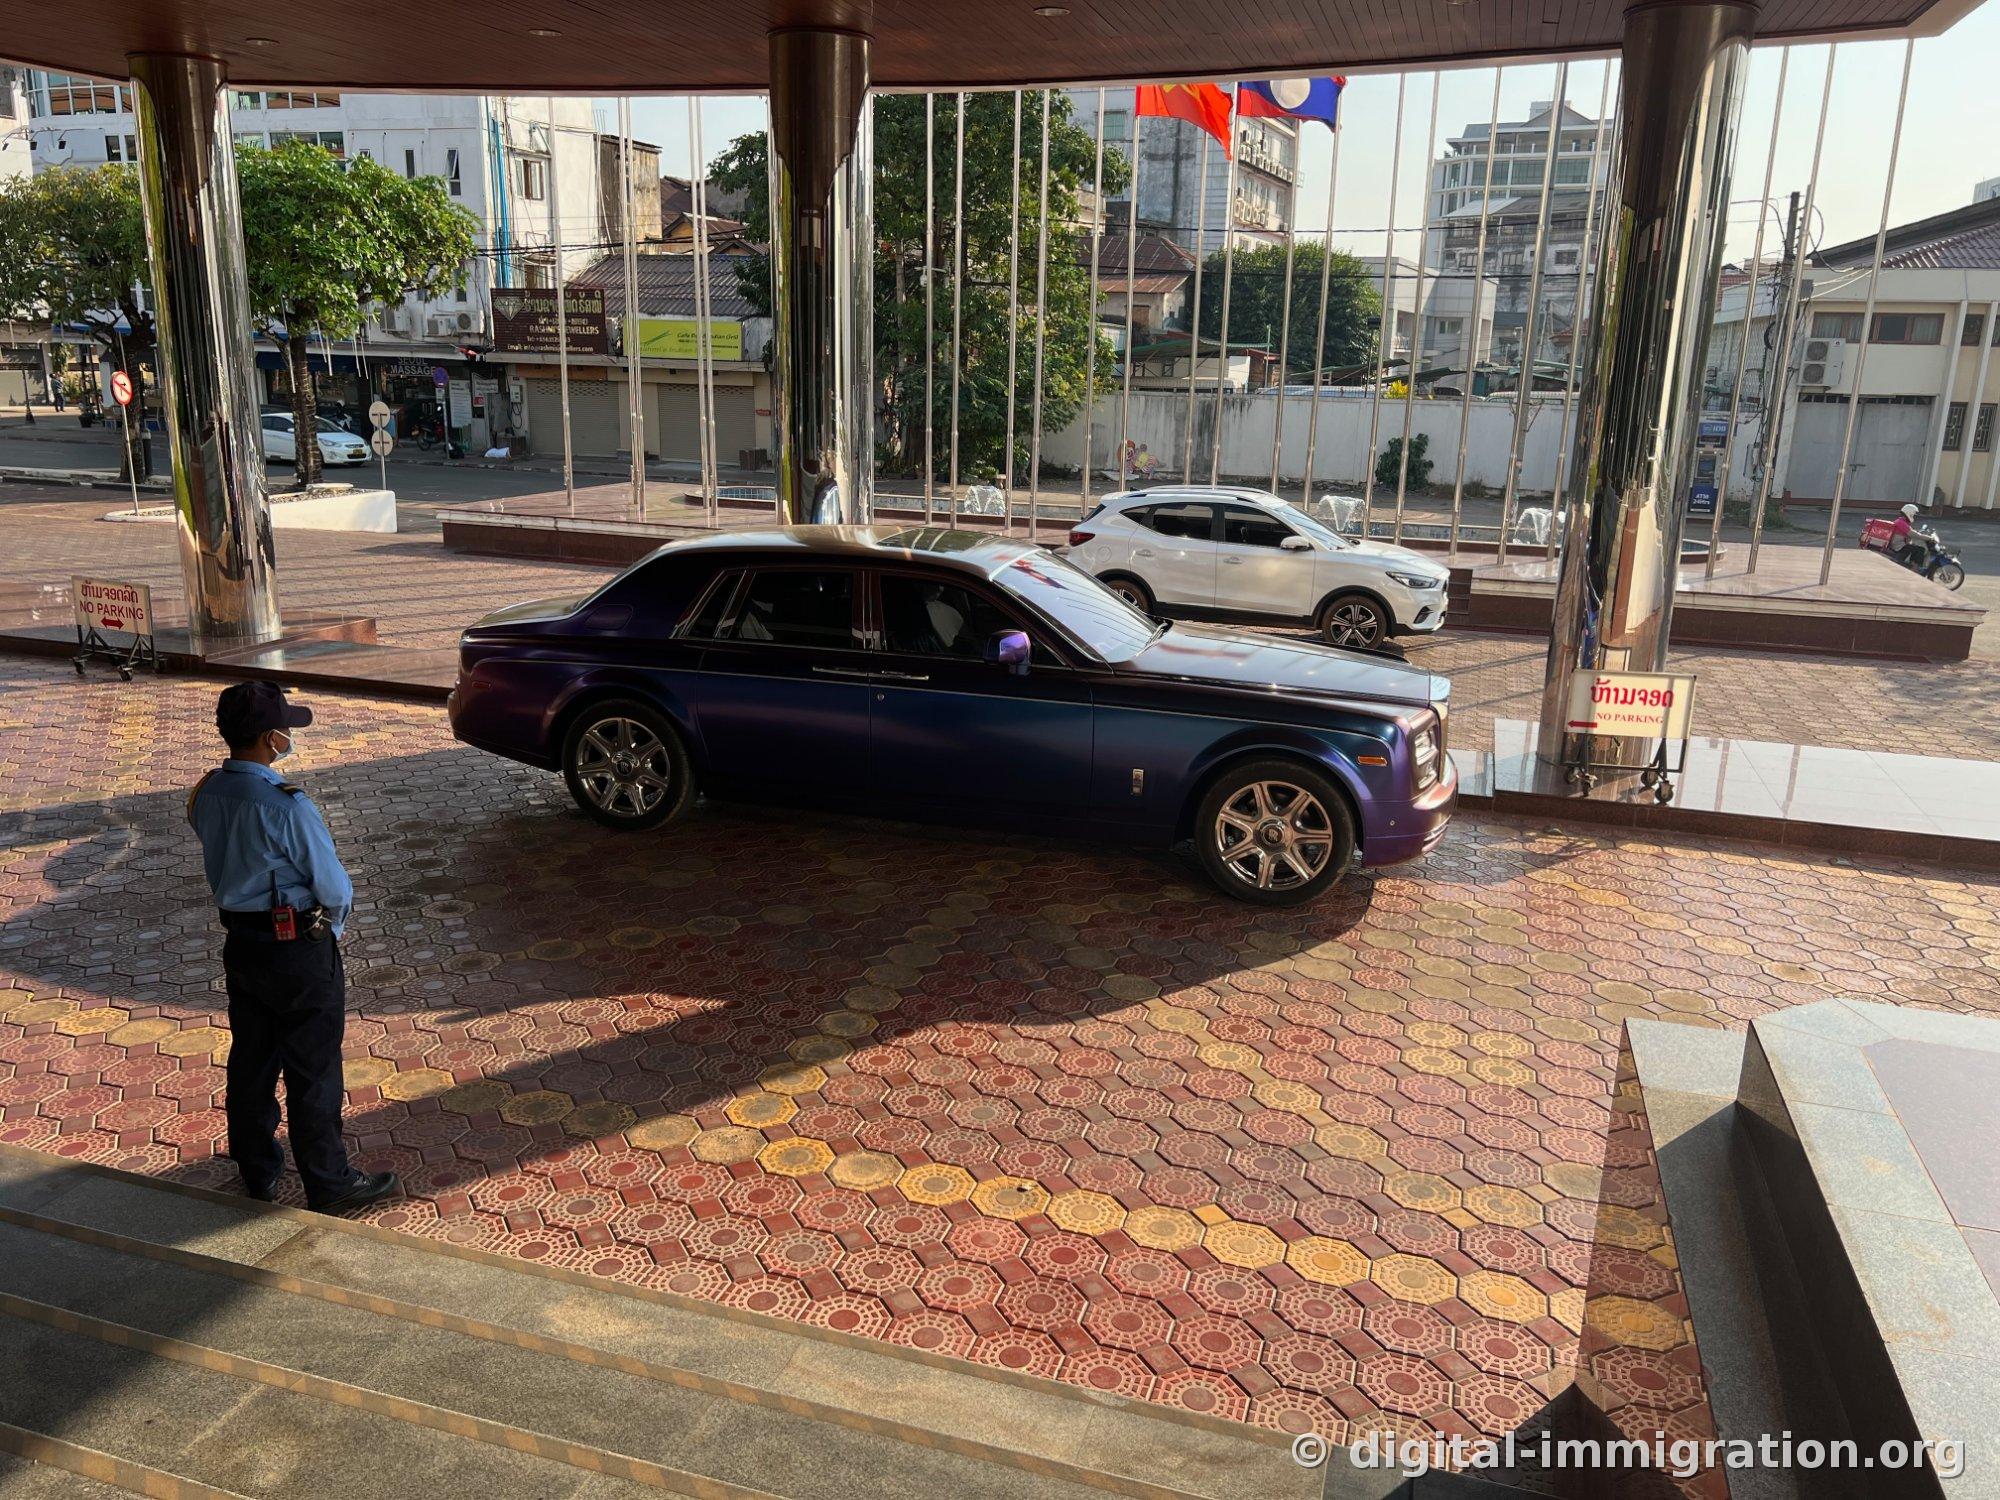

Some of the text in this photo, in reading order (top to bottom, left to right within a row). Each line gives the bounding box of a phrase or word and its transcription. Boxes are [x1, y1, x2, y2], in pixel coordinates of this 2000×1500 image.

[562, 326, 600, 335] EWELLERS
[390, 365, 436, 375] MASSAGE
[80, 601, 144, 620] NO PARKING
[1596, 712, 1664, 725] NO PARKING
